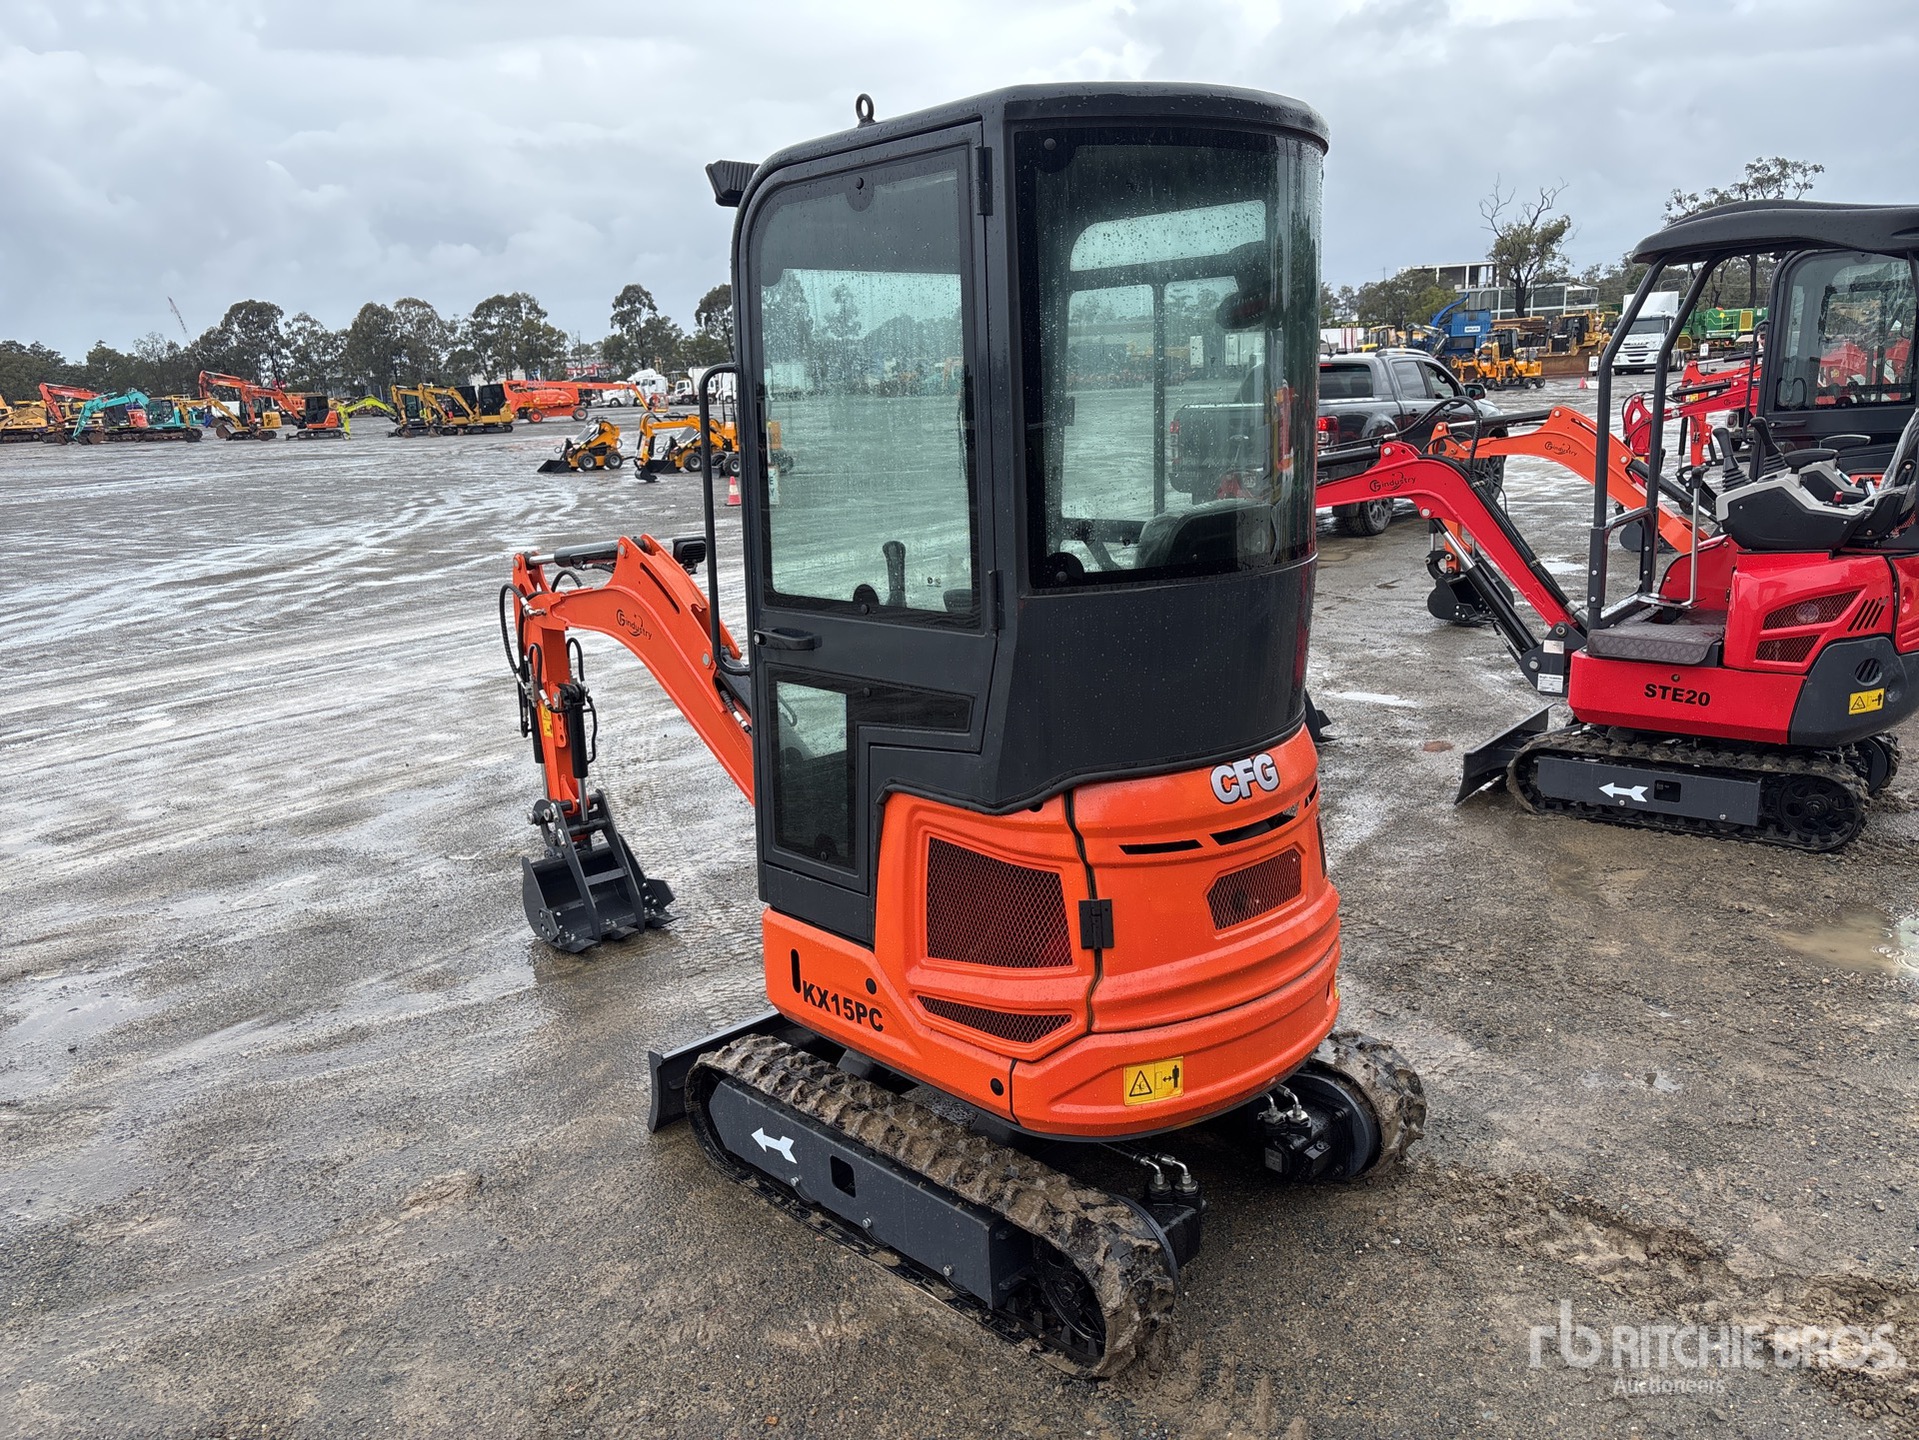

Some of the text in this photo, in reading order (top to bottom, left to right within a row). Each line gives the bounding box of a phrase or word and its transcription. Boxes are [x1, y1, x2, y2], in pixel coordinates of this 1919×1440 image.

[1644, 683, 1711, 706] STE20
[1210, 752, 1280, 804] CFG
[802, 980, 884, 1032] KX15PC
